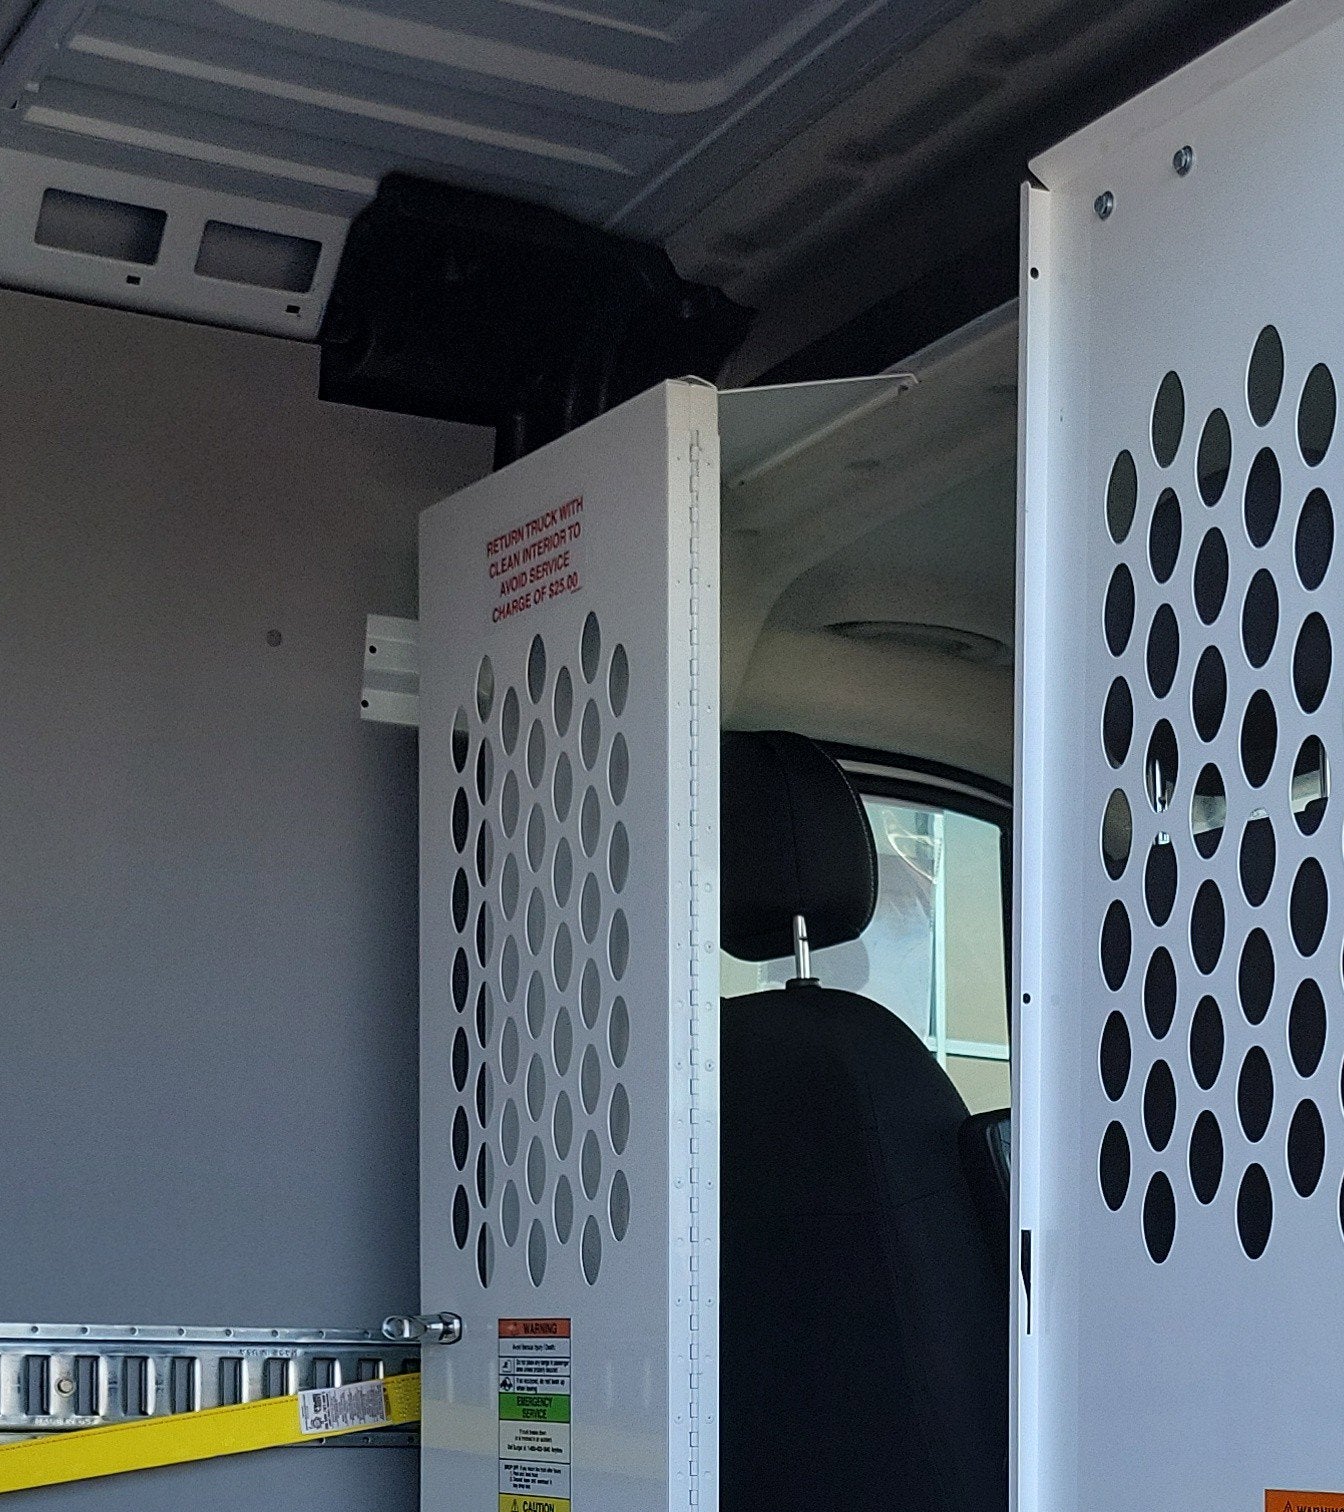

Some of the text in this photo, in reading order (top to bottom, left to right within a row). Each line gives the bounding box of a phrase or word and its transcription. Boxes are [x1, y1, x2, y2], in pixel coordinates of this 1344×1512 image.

[486, 495, 584, 558] RETURN TRUCK WITH
[489, 521, 581, 579] CLEAN INTERIOR TO
[500, 551, 570, 597] AVOID SERVICE
[492, 593, 531, 623] CHARGE
[533, 586, 547, 605] OF
[523, 1323, 558, 1335] WARNING
